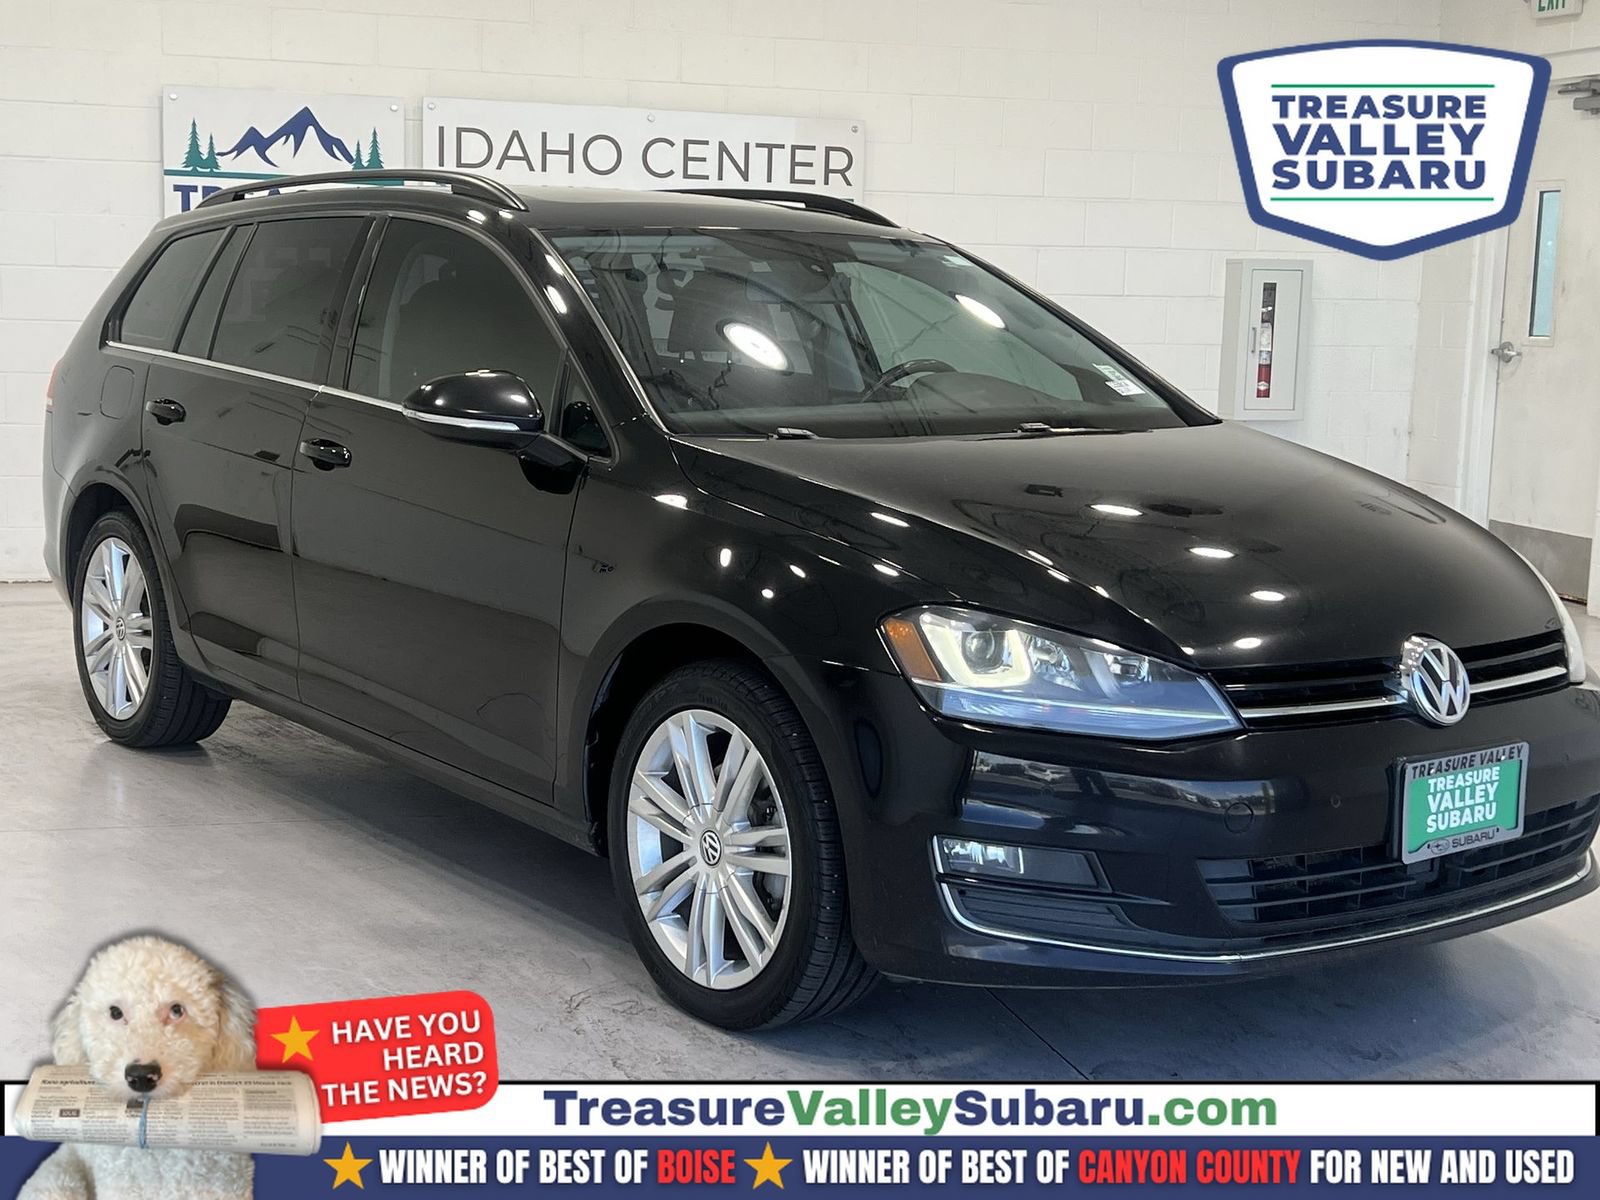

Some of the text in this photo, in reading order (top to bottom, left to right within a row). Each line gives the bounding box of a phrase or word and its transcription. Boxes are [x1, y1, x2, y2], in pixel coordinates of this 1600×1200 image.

[438, 126, 855, 187] IDAHO CENTER
[1411, 744, 1524, 779] TREASURE VALLEY
[1427, 766, 1501, 793] TREASURE
[1427, 781, 1499, 813] VALLEY
[1426, 801, 1497, 834] SUBARU
[1451, 829, 1495, 849] SUBARU
